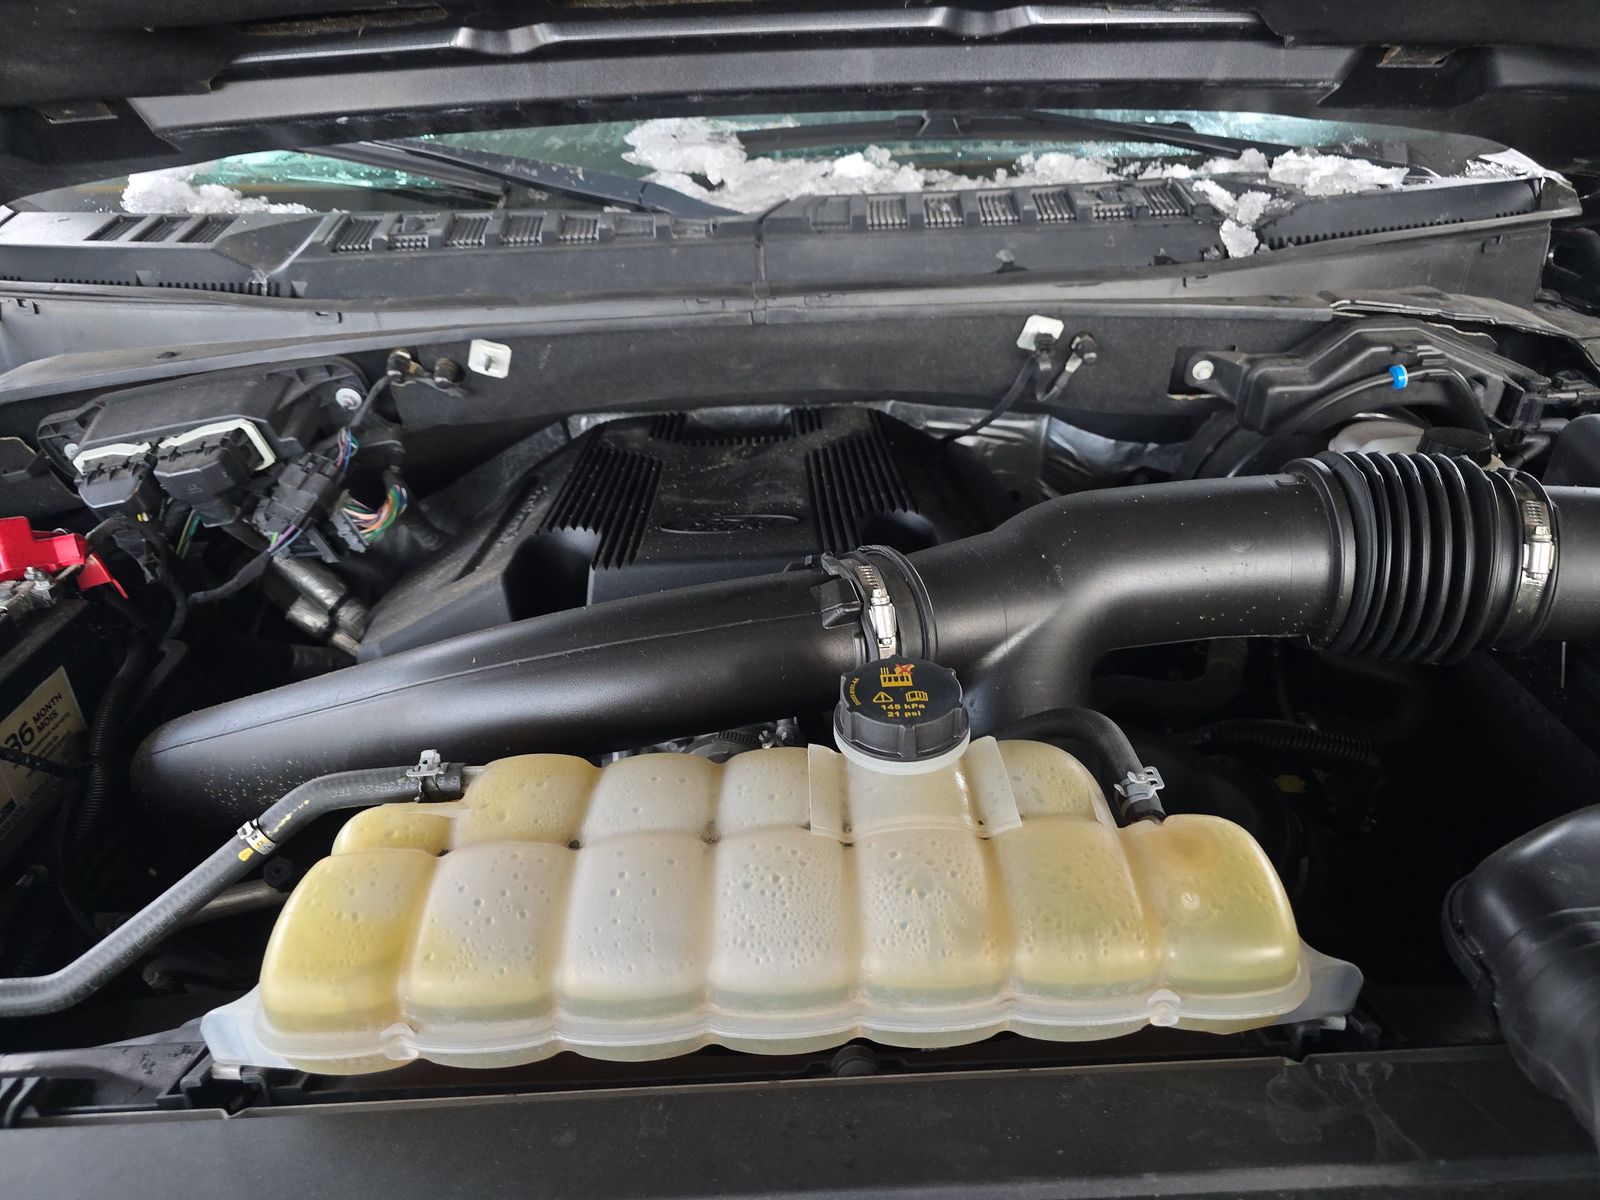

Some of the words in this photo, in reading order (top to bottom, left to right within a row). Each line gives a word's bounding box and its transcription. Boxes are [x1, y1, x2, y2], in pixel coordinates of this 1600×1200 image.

[880, 703, 901, 711] 145
[904, 710, 921, 718] psi
[4, 721, 34, 752] 36
[32, 691, 63, 725] MONTH
[36, 709, 58, 733] MOIS
